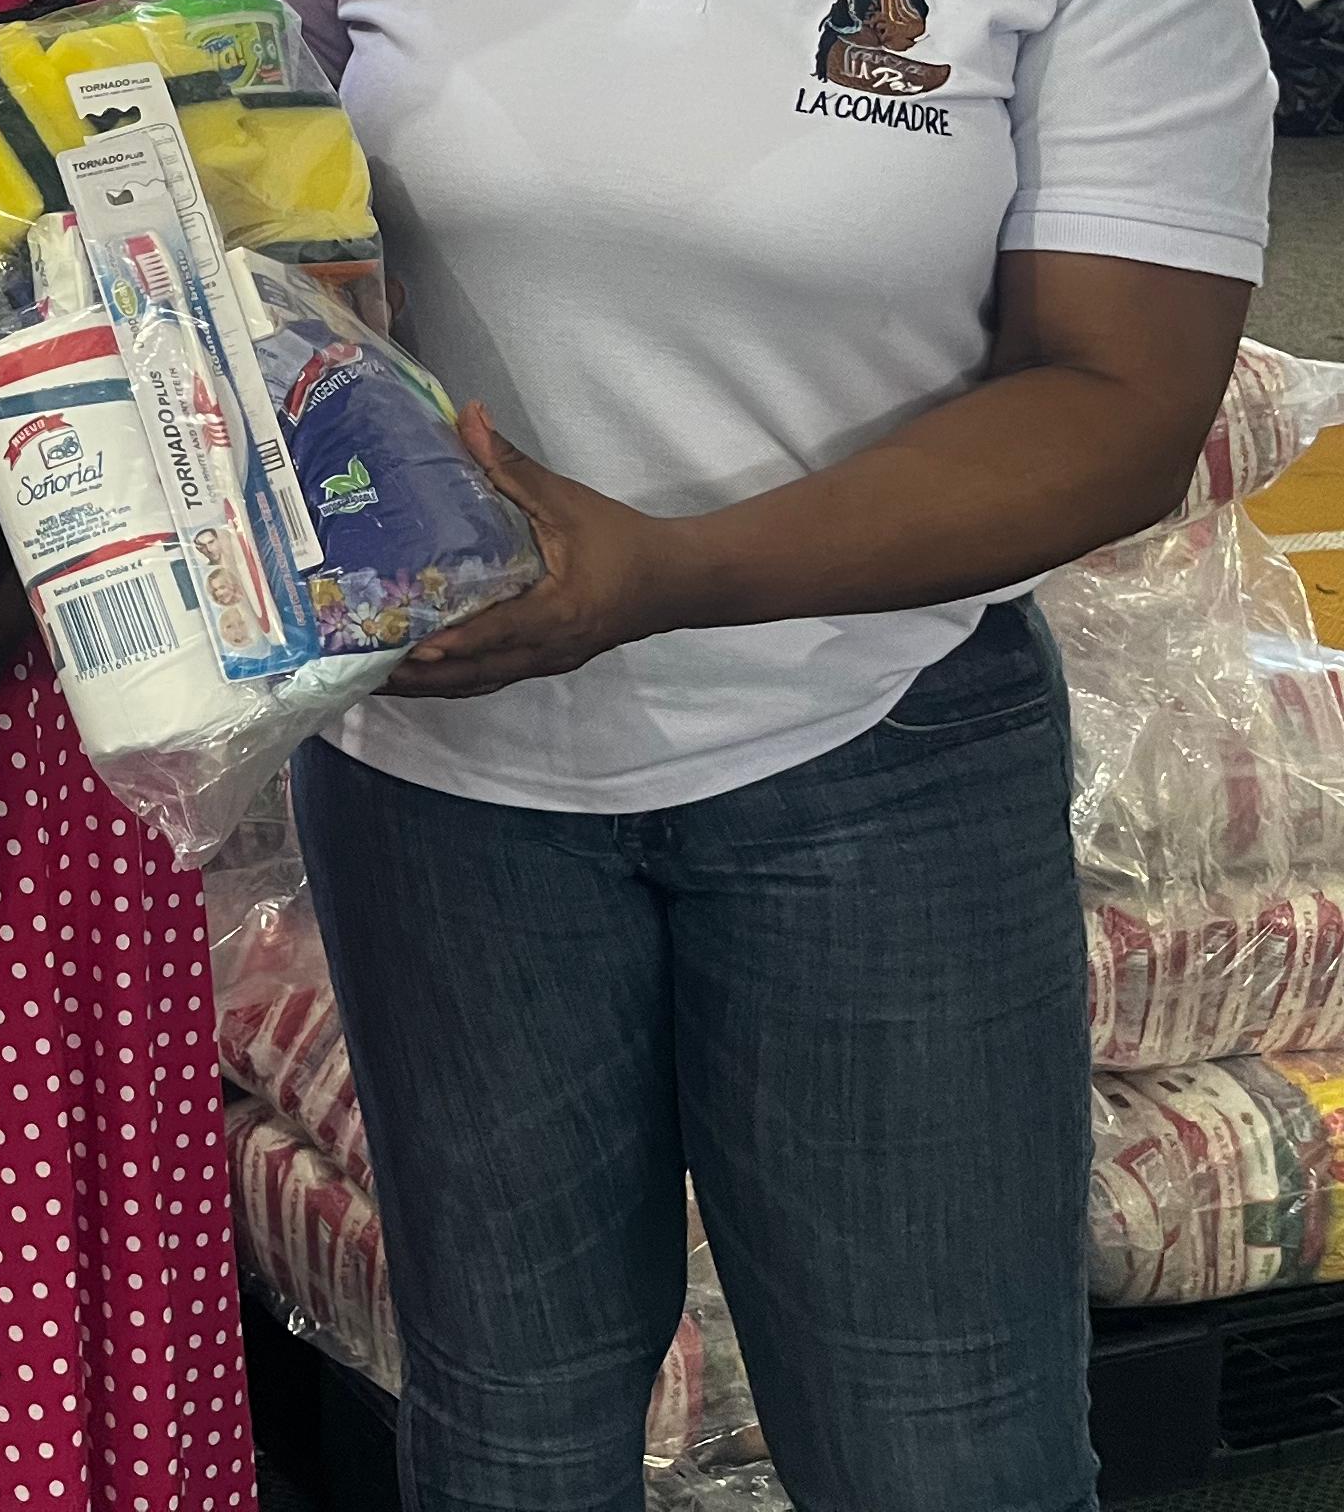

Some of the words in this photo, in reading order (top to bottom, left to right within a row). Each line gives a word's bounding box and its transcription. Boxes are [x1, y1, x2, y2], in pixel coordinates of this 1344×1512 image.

[79, 78, 130, 94] TORNADO
[795, 88, 829, 116] LA
[835, 93, 953, 136] COMADRE
[72, 154, 125, 172] TORNADO
[125, 151, 145, 162] PLUS
[150, 370, 171, 406] PLUS
[11, 418, 46, 446] NUEVO
[157, 409, 203, 510] TORNADO
[16, 450, 104, 506] Señorial
